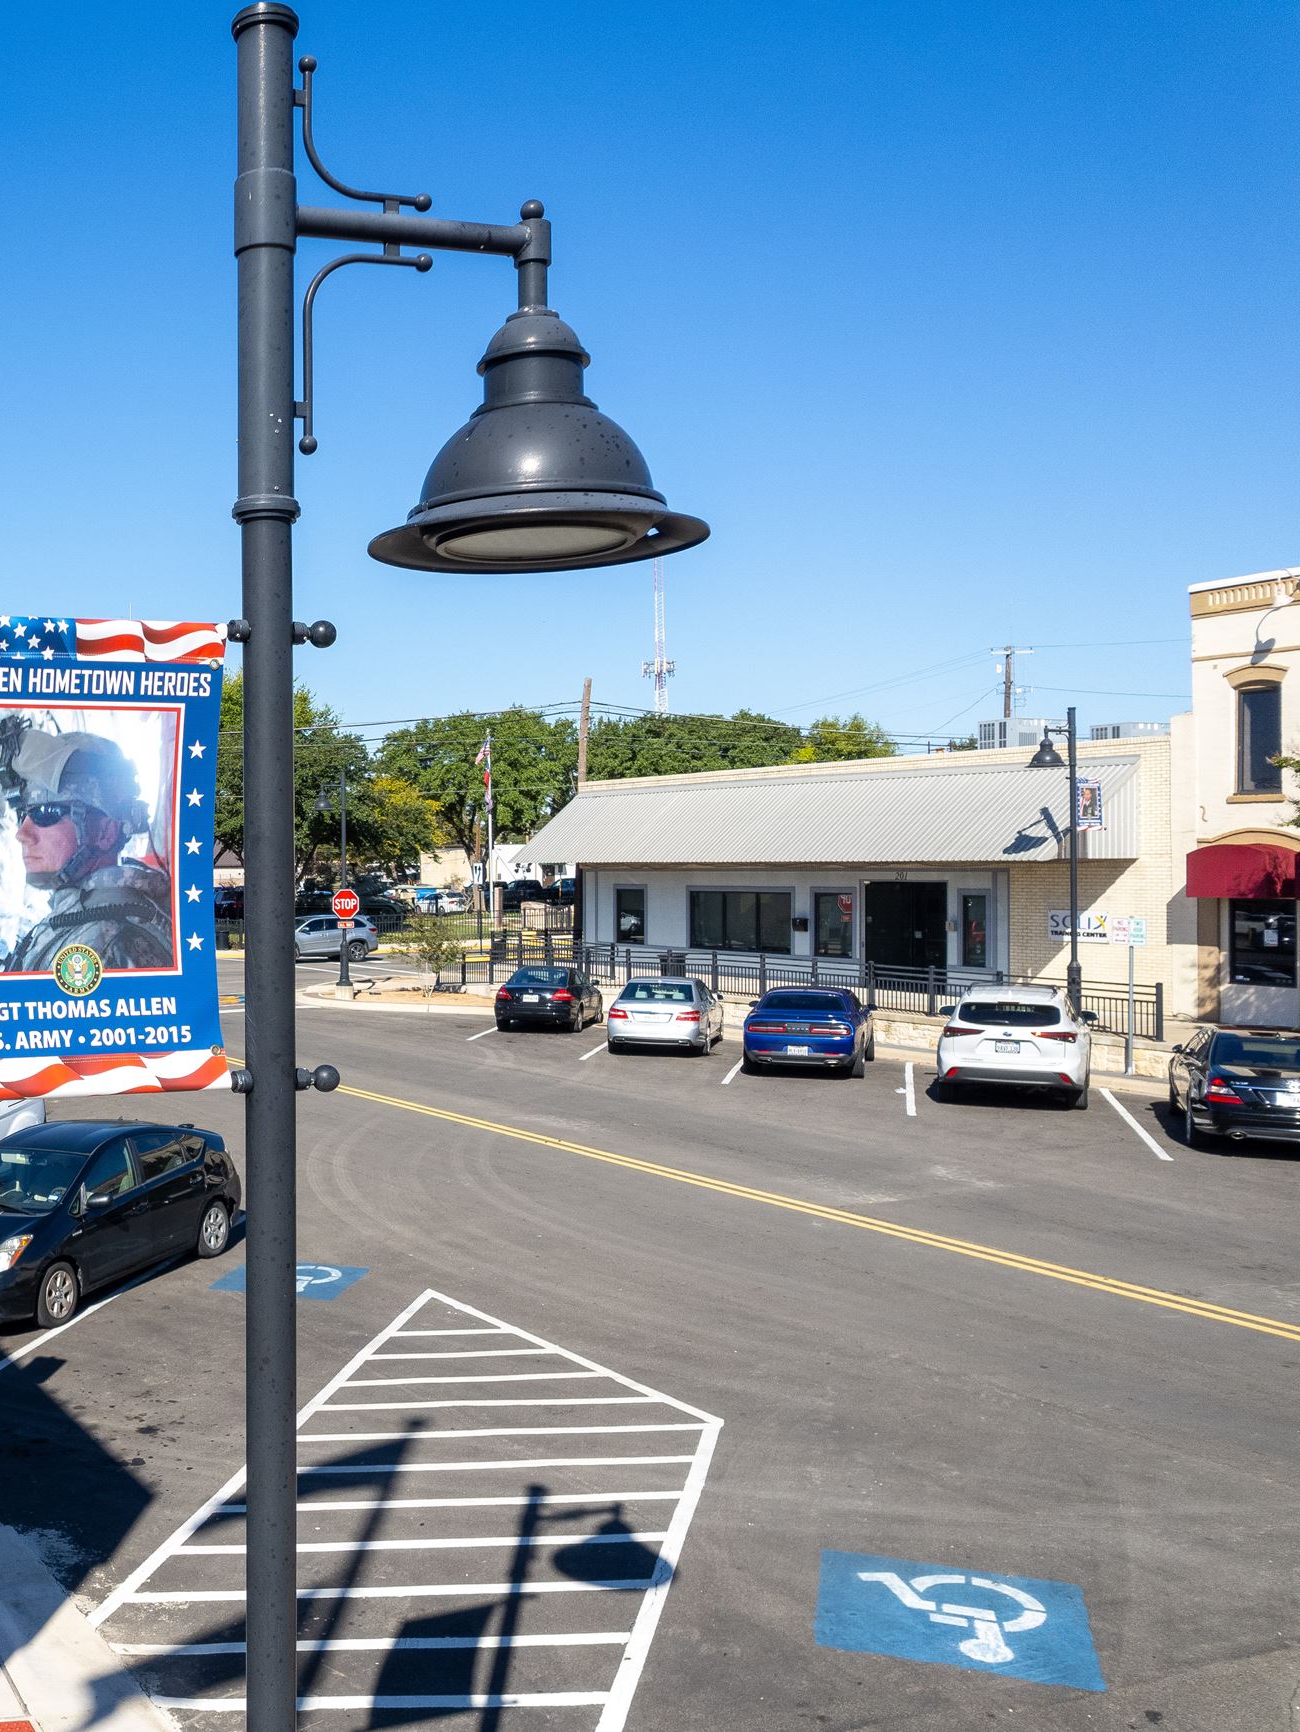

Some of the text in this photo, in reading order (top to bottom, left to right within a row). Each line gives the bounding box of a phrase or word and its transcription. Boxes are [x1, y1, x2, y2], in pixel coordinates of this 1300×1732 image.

[28, 668, 135, 695] HOMETOWN
[140, 671, 211, 697] HEROES
[894, 872, 908, 880] 201
[334, 898, 357, 910] STOP
[69, 985, 91, 994] ARMY
[24, 999, 110, 1020] THOMAS
[115, 996, 177, 1016] ALLEN
[15, 1029, 74, 1050] ARMY
[90, 1025, 192, 1047] 2001-2015
